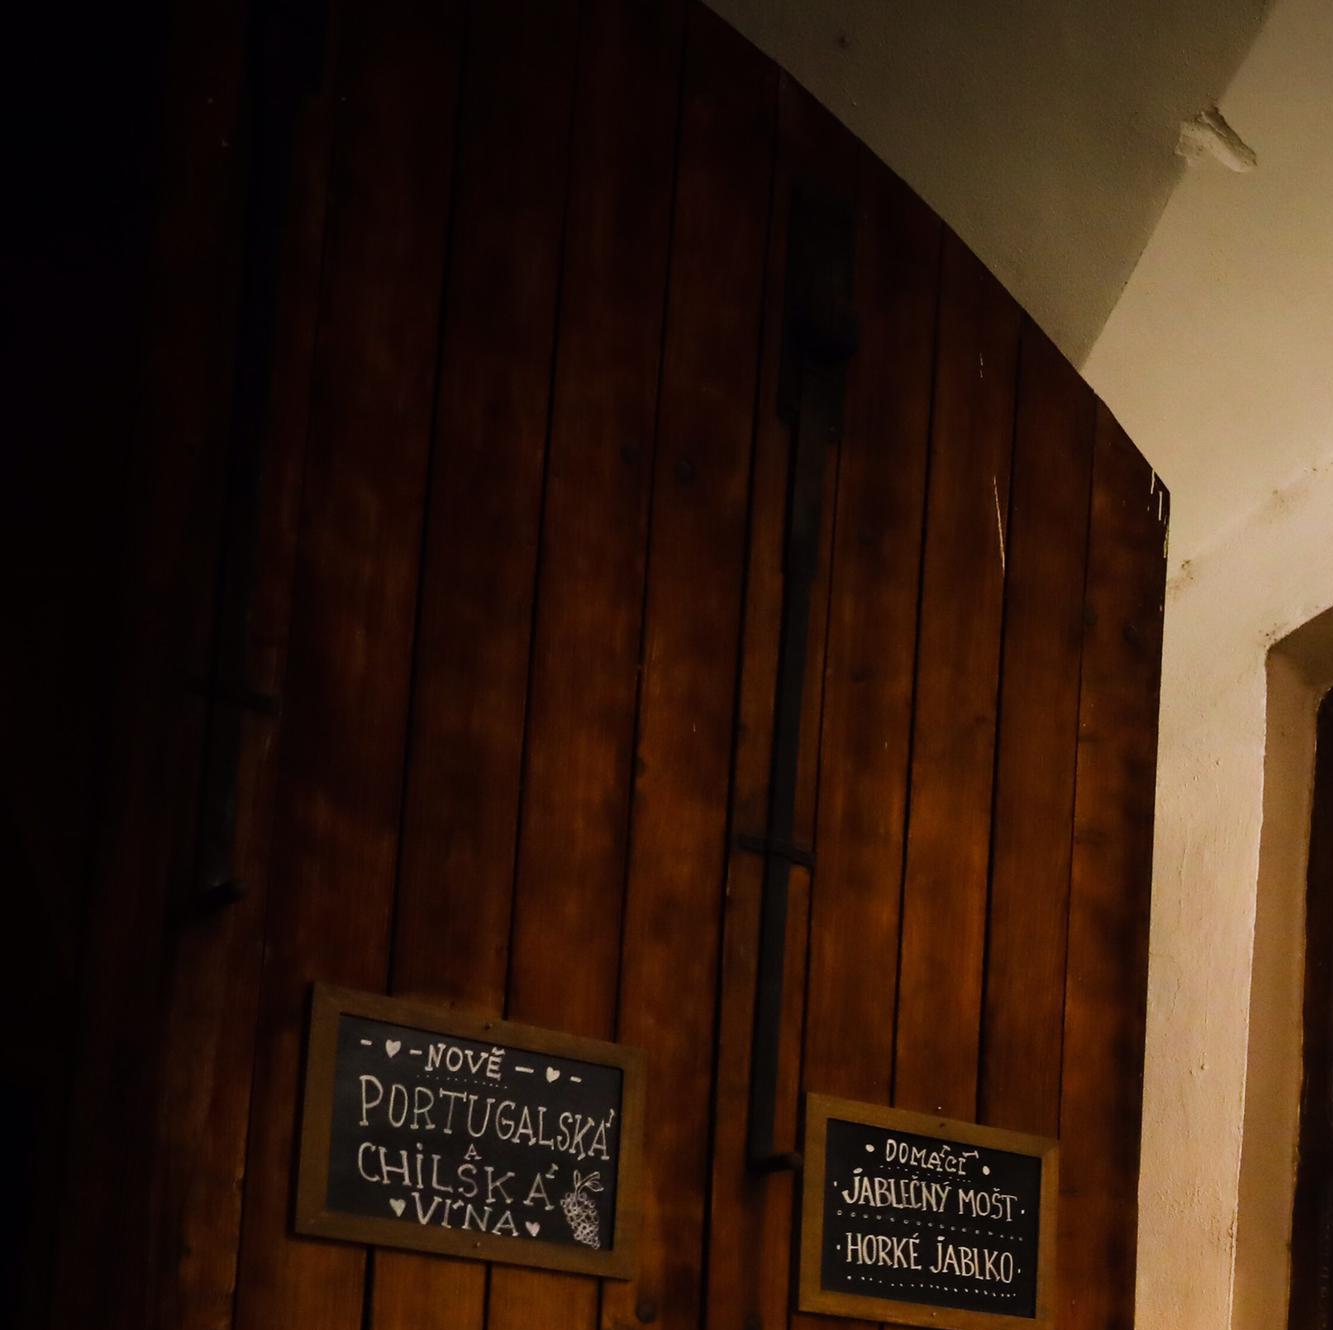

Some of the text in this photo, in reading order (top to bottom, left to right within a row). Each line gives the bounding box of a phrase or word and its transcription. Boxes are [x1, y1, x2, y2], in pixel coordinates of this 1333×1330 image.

[425, 1044, 504, 1080] NOVÉ
[359, 1075, 615, 1160] PORTUGALSKÁ
[463, 1143, 483, 1160] A
[885, 1139, 979, 1175] DOMÁCÍ
[411, 1192, 520, 1237] VÍNA
[842, 1167, 1017, 1222] JABLEČNÝ MOŠT
[846, 1232, 1013, 1283] HORKÉ JABLKO
